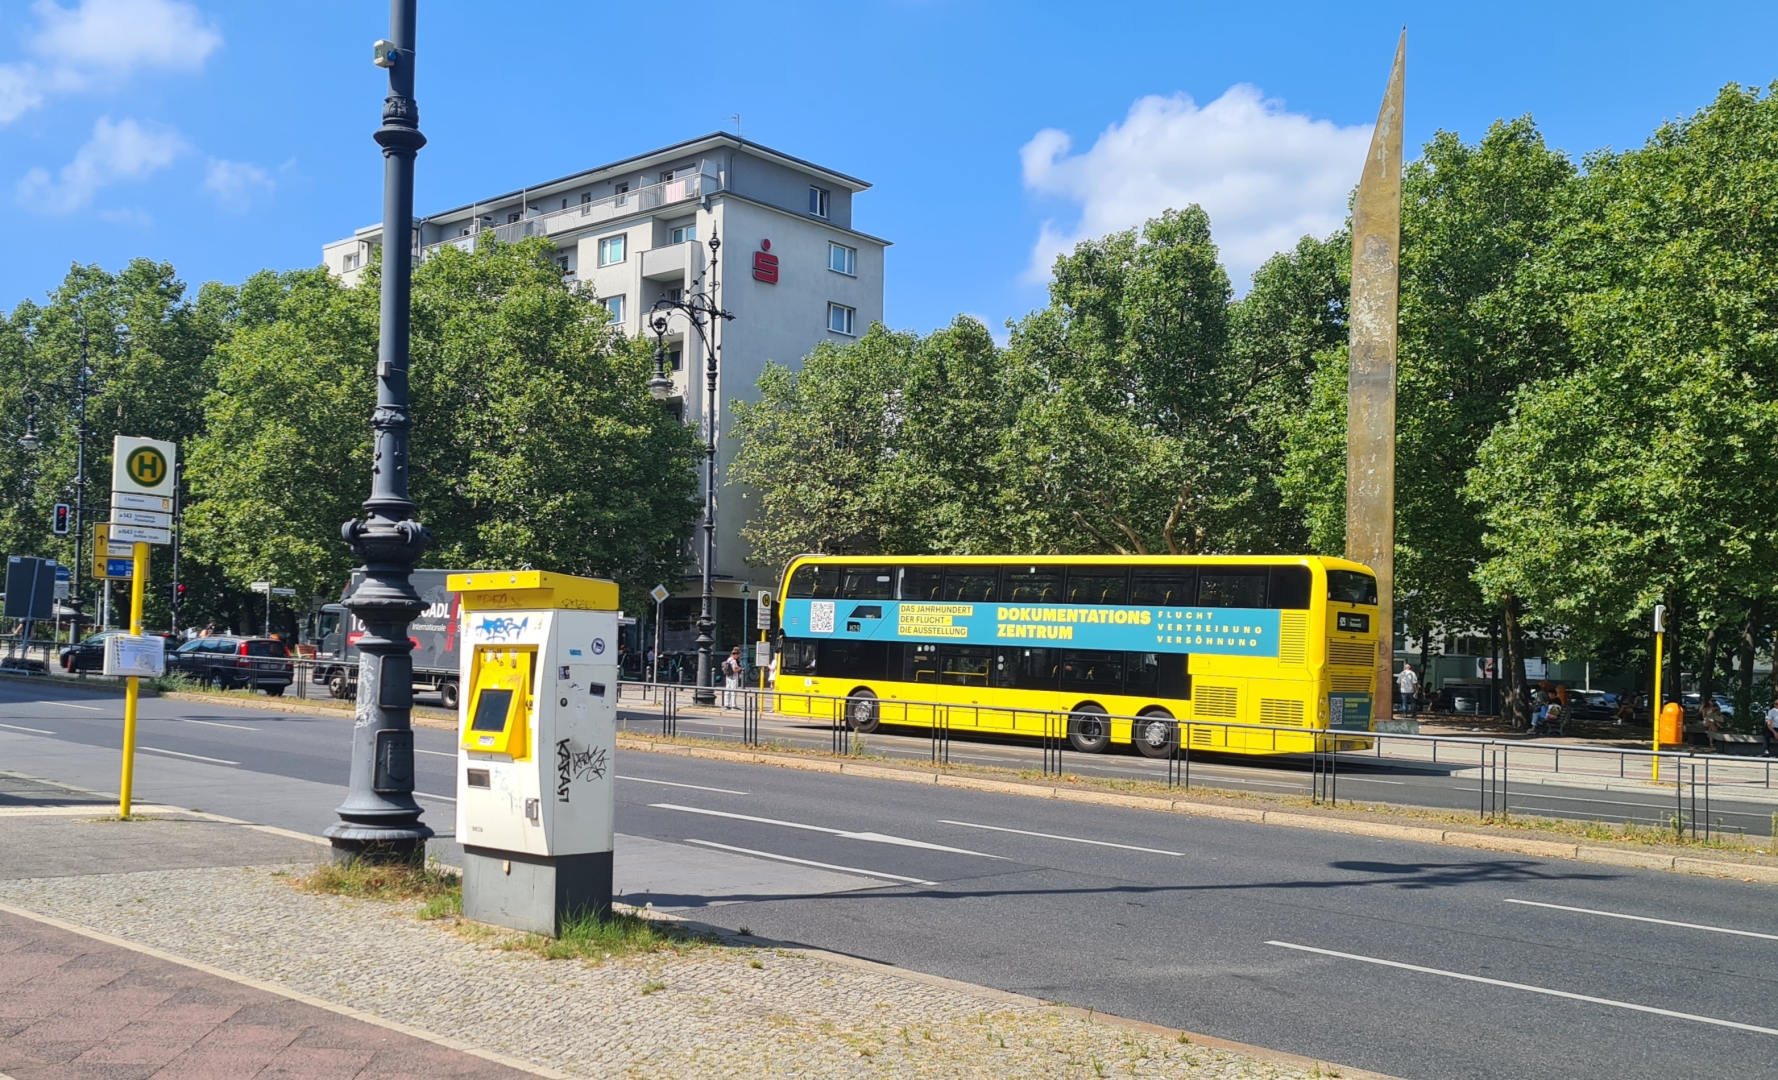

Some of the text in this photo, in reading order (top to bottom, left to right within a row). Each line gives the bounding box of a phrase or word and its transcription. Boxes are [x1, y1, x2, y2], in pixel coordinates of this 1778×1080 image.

[138, 455, 157, 478] H
[900, 605, 972, 614] DAS JAHRHUNDERT
[900, 615, 915, 623] DER
[916, 616, 945, 624] FLUCHT
[997, 606, 1152, 625] DOKUMENTATIONS
[1158, 610, 1213, 620] FLUCHT
[412, 623, 447, 632] Internationale
[899, 626, 967, 636] DIE AUSSTELLUNG
[996, 623, 1073, 640] ZENTRUM
[1157, 623, 1262, 634] VERTREIBUNG
[1157, 635, 1257, 647] VERSÖHNUNG
